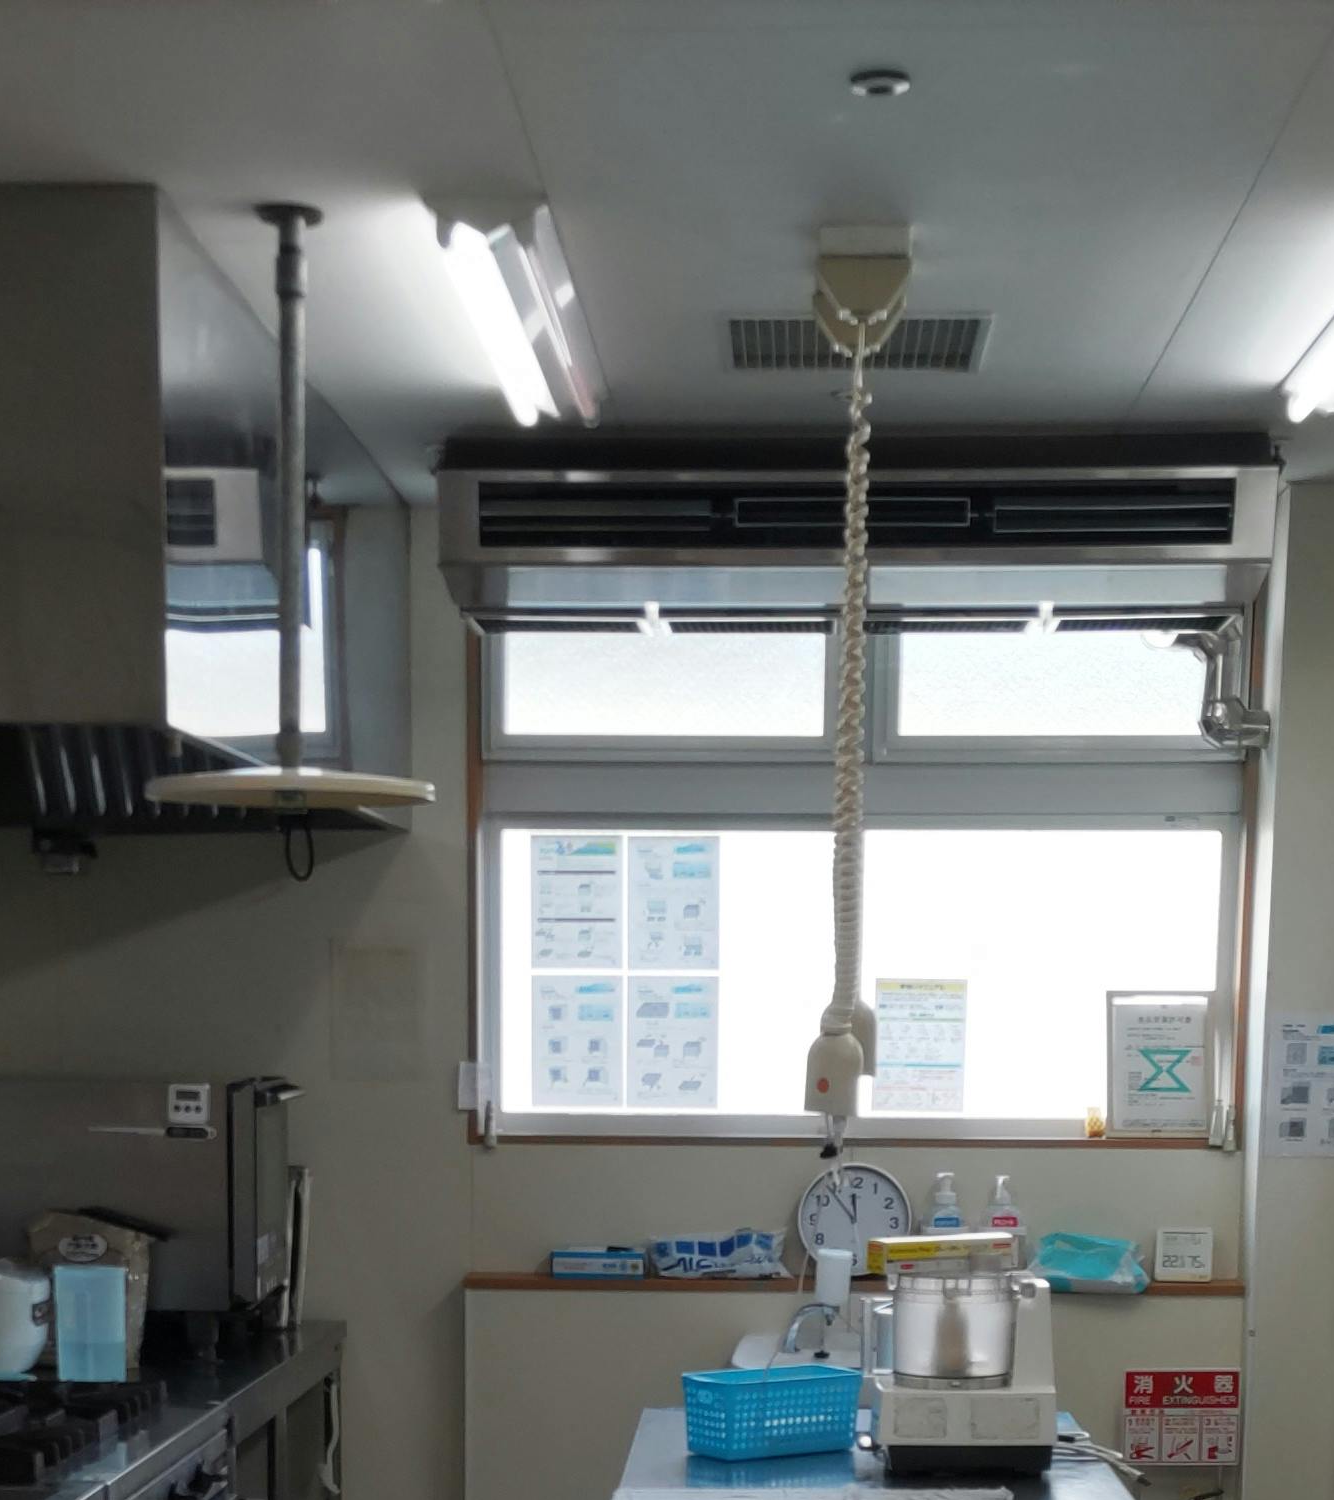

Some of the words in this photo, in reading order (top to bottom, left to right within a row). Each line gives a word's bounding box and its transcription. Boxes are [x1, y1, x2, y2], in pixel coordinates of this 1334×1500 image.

[872, 1183, 878, 1195] 1
[884, 1197, 894, 1210] 2
[889, 1217, 900, 1229] 3
[814, 1233, 825, 1246] 8
[1133, 1374, 1234, 1394] 消火器
[1129, 1395, 1151, 1405] FIRE
[1163, 1395, 1237, 1405] EXTINGUISHER
